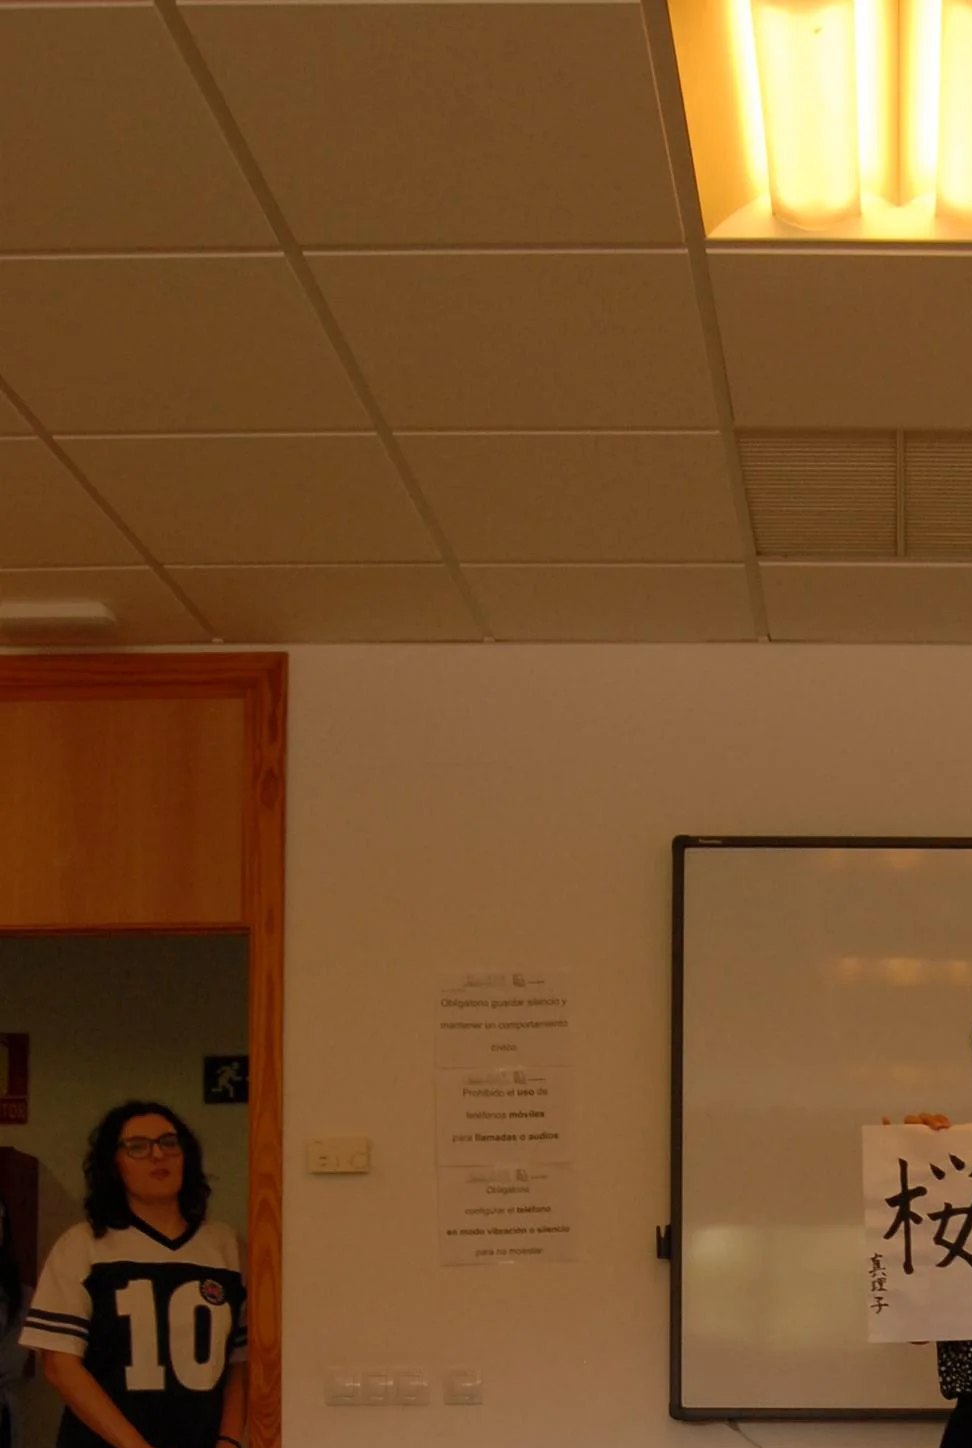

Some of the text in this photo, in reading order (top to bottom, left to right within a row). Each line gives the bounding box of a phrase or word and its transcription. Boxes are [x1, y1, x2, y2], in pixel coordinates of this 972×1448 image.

[441, 998, 489, 1009] Obligatorio
[491, 998, 524, 1009] guardar
[527, 998, 559, 1007] silencio
[440, 1020, 568, 1031] mantener un comportamiento
[462, 1087, 548, 1098] Prohibido el uso de
[466, 1109, 545, 1120] teléfonos móviles
[452, 1134, 472, 1143] para
[474, 1132, 517, 1142] llamadas
[528, 1131, 559, 1141] audios
[465, 1206, 505, 1216] configurar
[507, 1206, 515, 1214] el
[446, 1228, 458, 1236] en
[459, 1227, 485, 1236] modo
[487, 1225, 527, 1235] vibración
[537, 1224, 571, 1233] silencio
[475, 1246, 543, 1258] para no molestar
[868, 1252, 889, 1314] 真理子
[115, 1278, 232, 1391] 10
